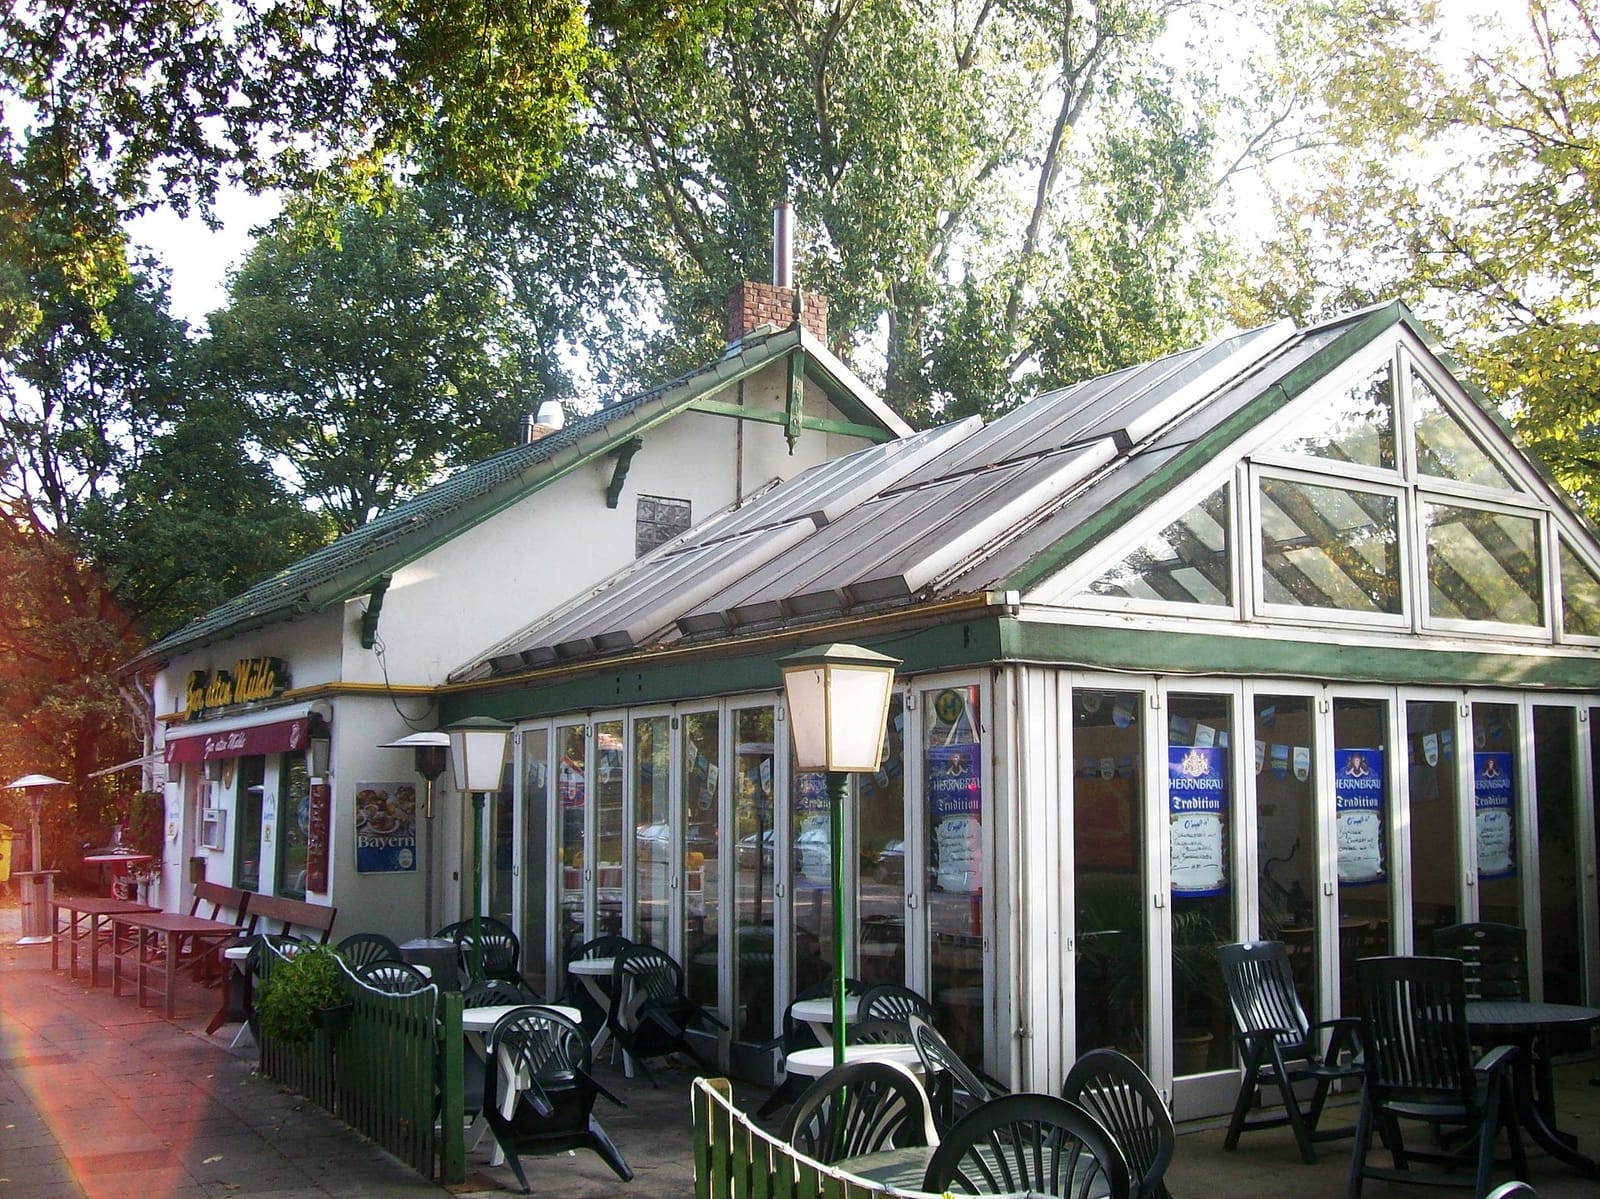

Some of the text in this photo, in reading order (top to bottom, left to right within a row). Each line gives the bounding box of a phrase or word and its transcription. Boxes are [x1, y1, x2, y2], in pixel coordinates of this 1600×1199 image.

[1173, 796, 1220, 810] Tradition
[1336, 795, 1379, 808] Tradition
[358, 834, 415, 850] Bayern
